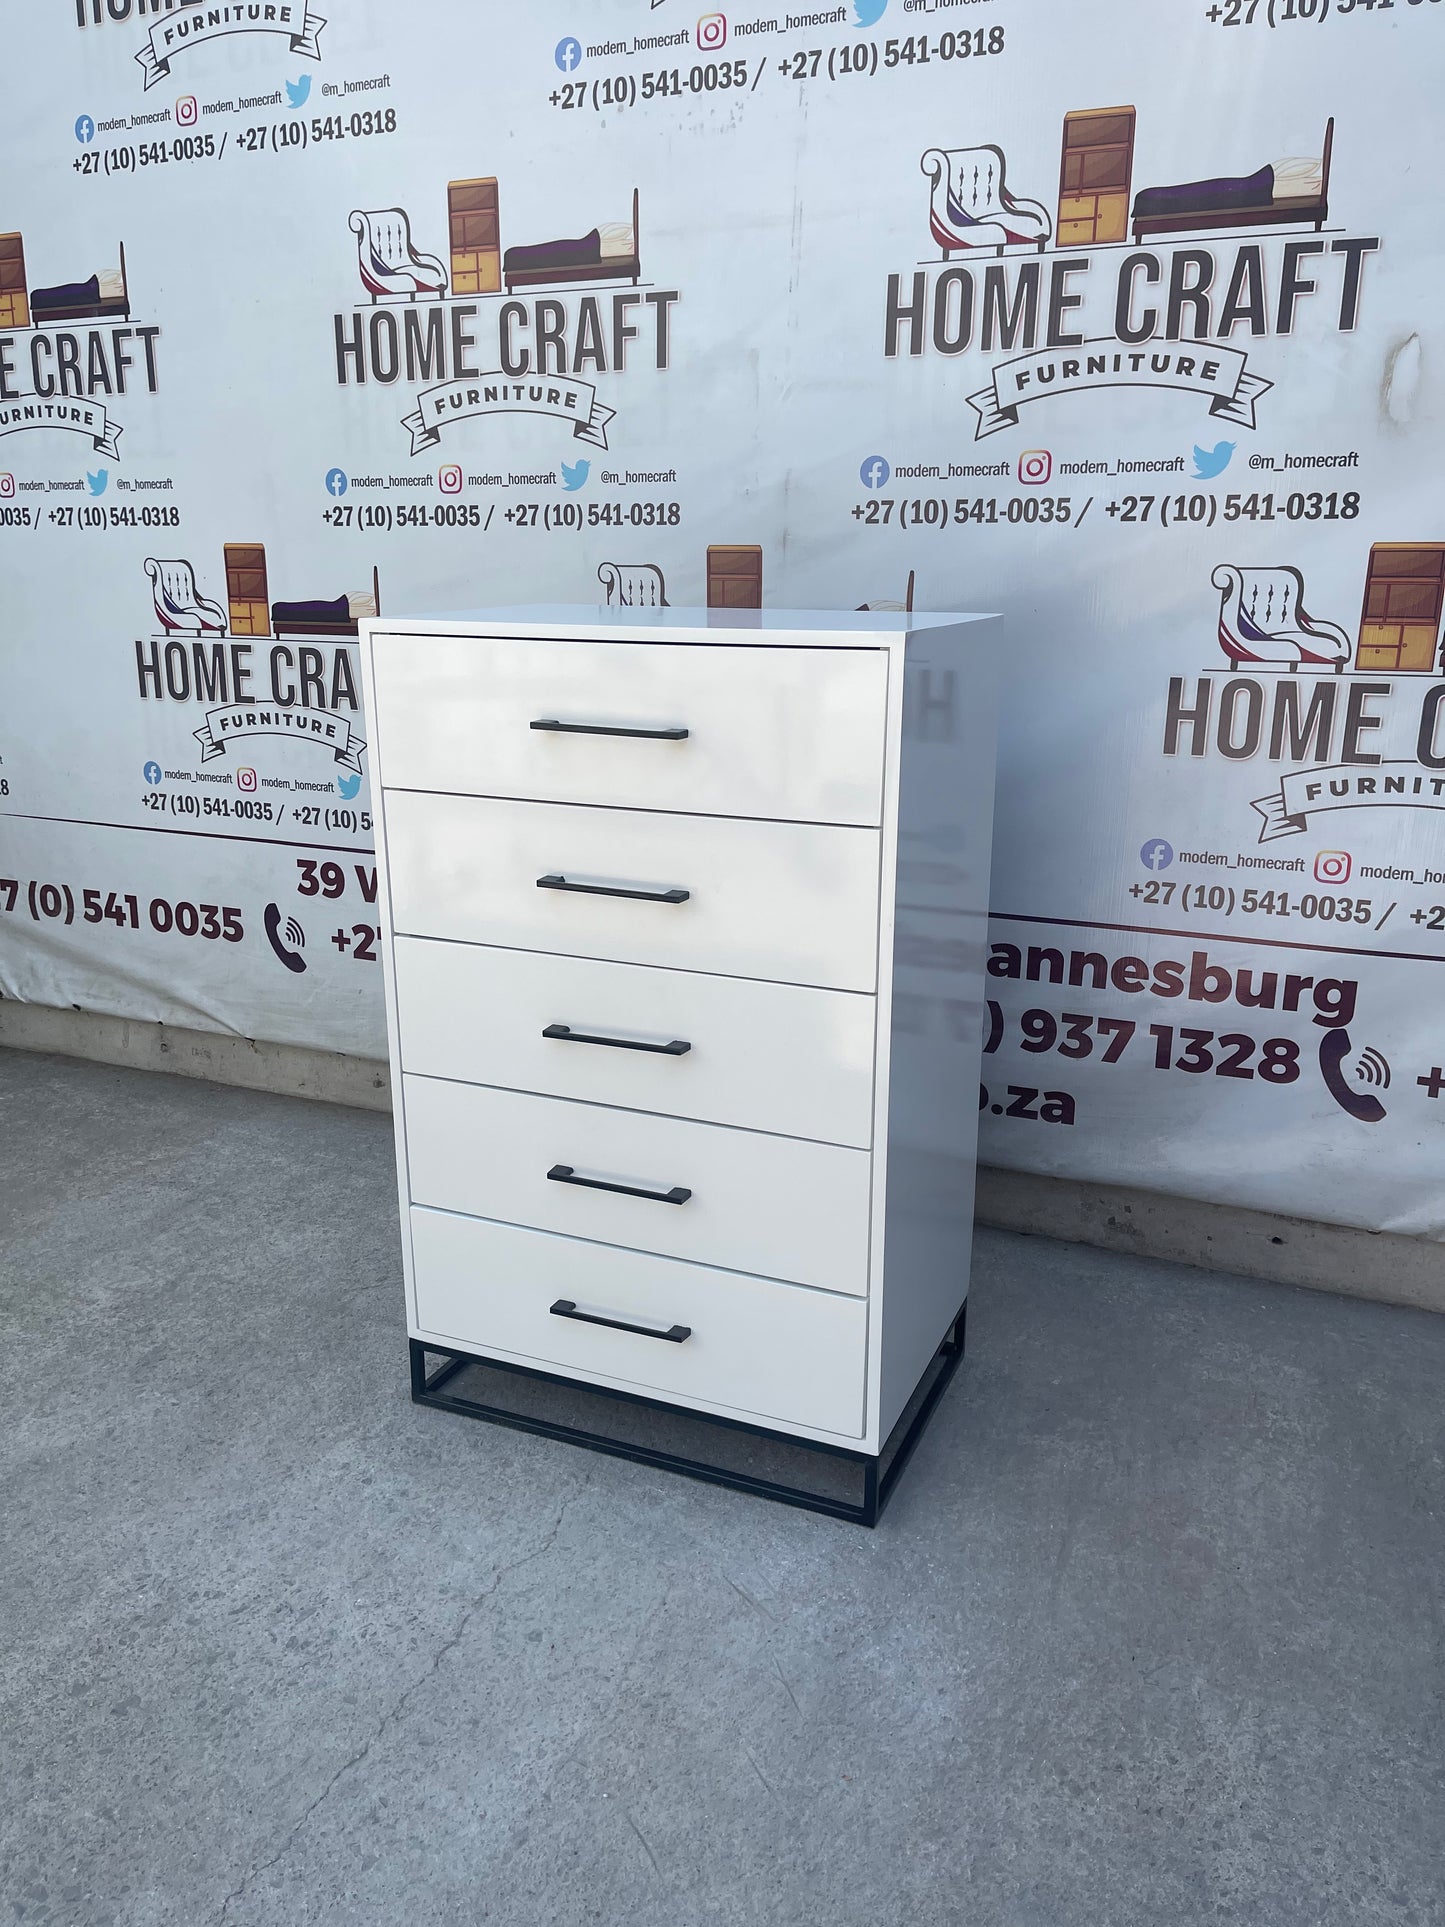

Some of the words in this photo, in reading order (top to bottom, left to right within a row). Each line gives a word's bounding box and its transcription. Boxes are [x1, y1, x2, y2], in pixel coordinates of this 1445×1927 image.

[163, 5, 292, 46] FURNITURE
[322, 74, 390, 96] @m_homecraft
[549, 82, 587, 109] +27
[593, 76, 636, 111] (10)
[642, 60, 747, 99] 541-0035
[778, 50, 822, 79] +27
[828, 43, 877, 81] (10)
[884, 26, 1004, 67] 541-0318
[73, 152, 100, 174] +27
[105, 147, 135, 175] (10)
[140, 134, 214, 165] 541-0035
[237, 127, 266, 151] +27
[272, 121, 307, 152] (10)
[312, 109, 396, 142] 541-0318
[885, 259, 1089, 357] HOME
[1115, 238, 1379, 344] CRAFT
[334, 305, 479, 385] HOME
[500, 291, 678, 377] CRAFT
[30, 327, 159, 397] CRAFT
[1016, 353, 1220, 390] FURNITURE
[435, 386, 577, 414] FURNITURE
[601, 469, 676, 485] @m_homecraft
[1249, 452, 1359, 471] @m_homecraft
[117, 478, 173, 491] @m_homecraft
[49, 507, 73, 525] +27
[78, 507, 107, 530] (10)
[110, 507, 179, 526] 541-0318
[323, 506, 353, 526] +27
[358, 506, 392, 531] (10)
[397, 505, 480, 526] 541-0035
[505, 505, 539, 526] +27
[544, 504, 582, 531] (10)
[588, 503, 680, 526] 541-0318
[852, 500, 894, 524] +27
[900, 499, 948, 529] (10)
[954, 498, 1070, 523] 541-0035
[1105, 496, 1155, 521] +27
[1161, 495, 1216, 527] (10)
[1224, 492, 1360, 520] 541-0318
[135, 641, 255, 704] HOME
[220, 712, 337, 738] FURNITURE
[1163, 677, 1391, 764] HOME
[1306, 777, 1445, 800] FURNIT
[142, 793, 166, 810] +27
[171, 795, 200, 817] (10)
[203, 798, 272, 820] 541-0035
[293, 807, 320, 825] +27
[325, 809, 357, 833] (10)
[297, 859, 345, 898] 39
[28, 881, 74, 925] (0)
[83, 889, 139, 929] 541
[150, 899, 243, 942] 0035
[1129, 881, 1176, 904] +27
[1182, 884, 1235, 916] (10)
[1241, 889, 1371, 924] 541-0035
[332, 924, 381, 961] +2
[986, 942, 1358, 1028] annesburg
[1020, 1009, 1135, 1063] 937
[1150, 1024, 1300, 1083] 1328
